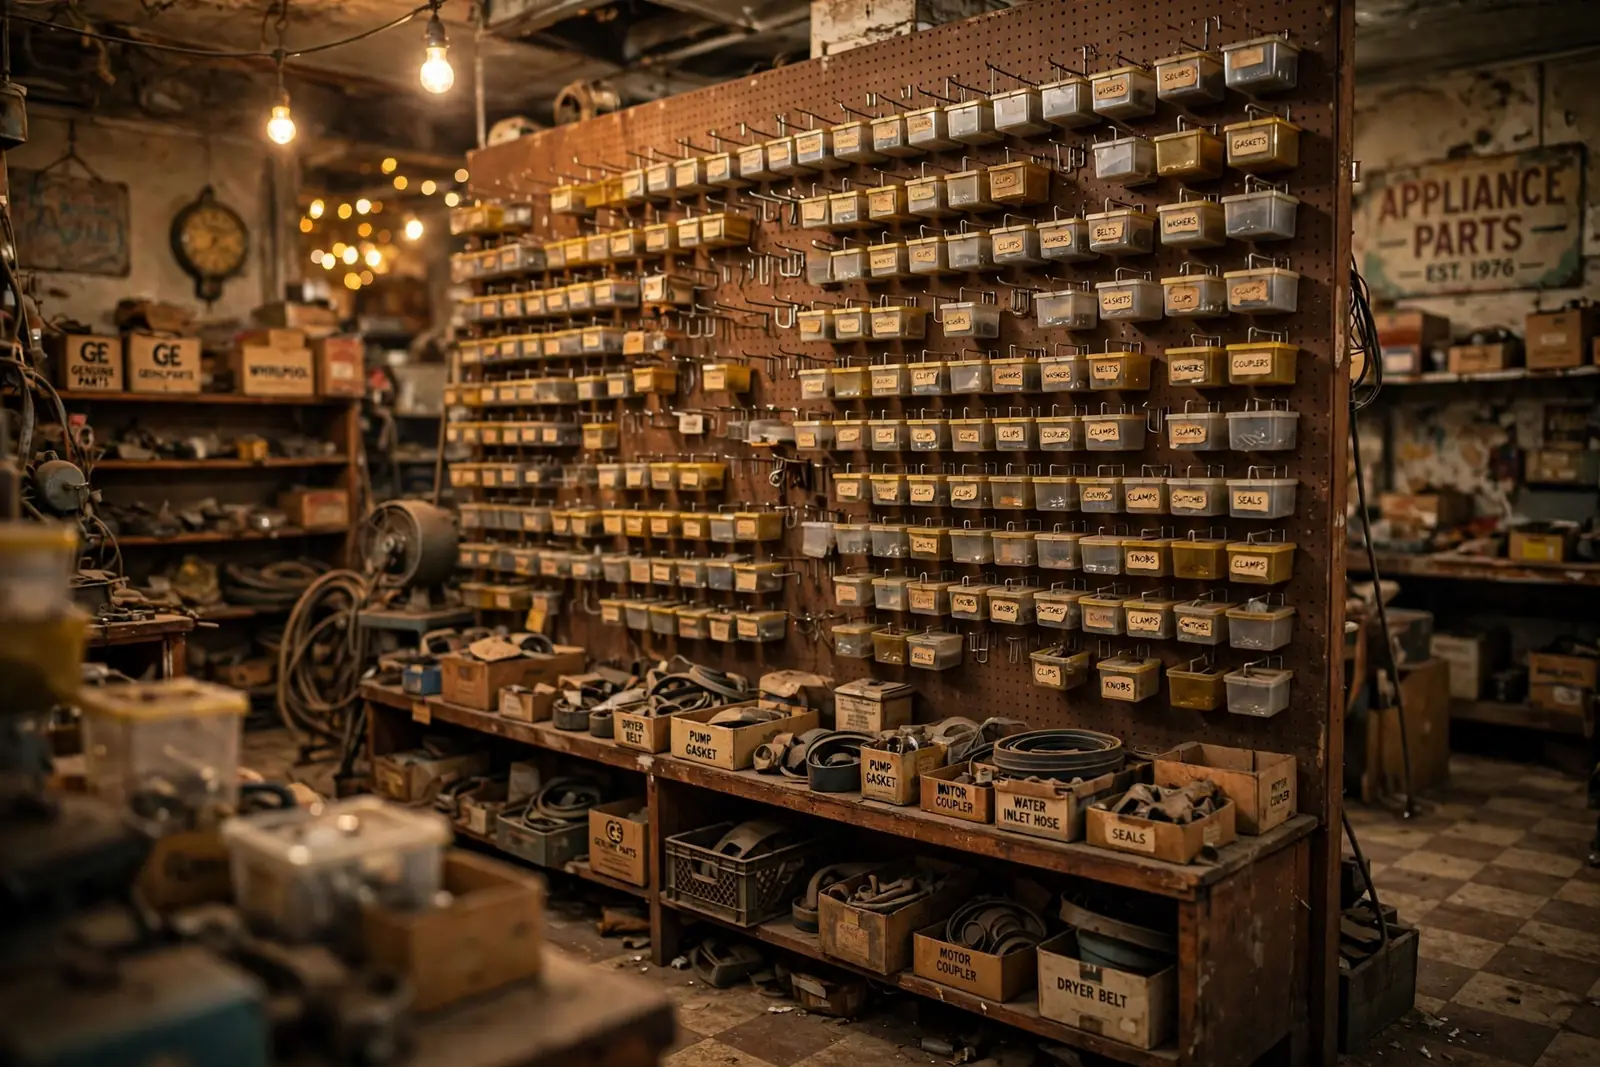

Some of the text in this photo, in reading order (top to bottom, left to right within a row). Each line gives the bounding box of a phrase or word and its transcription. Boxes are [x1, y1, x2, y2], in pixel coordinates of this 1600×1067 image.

[1234, 136, 1267, 150] GASKETS
[1379, 166, 1566, 221] APPLIANCE
[1166, 215, 1197, 229] WASHERS
[1096, 227, 1117, 238] BELTS
[1415, 215, 1523, 259] PARTS
[1470, 258, 1515, 278] 1976
[80, 342, 110, 364] GE
[152, 342, 182, 367] GE
[1172, 363, 1205, 375] WASHERS
[1233, 357, 1270, 369] COUPLERS
[1001, 429, 1020, 439] CLIPS
[1089, 426, 1117, 437] CLAMPS
[954, 489, 973, 498] CLIPS
[1237, 495, 1263, 506] SEALS
[1234, 559, 1266, 571] CLAMPS
[1130, 615, 1159, 627] CLAMPS
[1037, 667, 1057, 679] CLIPS
[1105, 681, 1132, 693] KNOBS
[622, 719, 644, 733] DRYER
[626, 731, 643, 744] BELT
[689, 730, 712, 745] PUMP
[685, 743, 718, 761] GASKET
[869, 759, 893, 774] PUMP
[866, 771, 897, 788] GASKET
[935, 795, 974, 814] COUPLER
[1013, 795, 1047, 813] WATER
[1003, 808, 1061, 831] INLET HOSE
[1112, 828, 1147, 845] SEALS
[940, 947, 972, 966] MOTOR
[936, 960, 978, 982] COUPLER
[1057, 976, 1129, 1010] DRYER BELT
